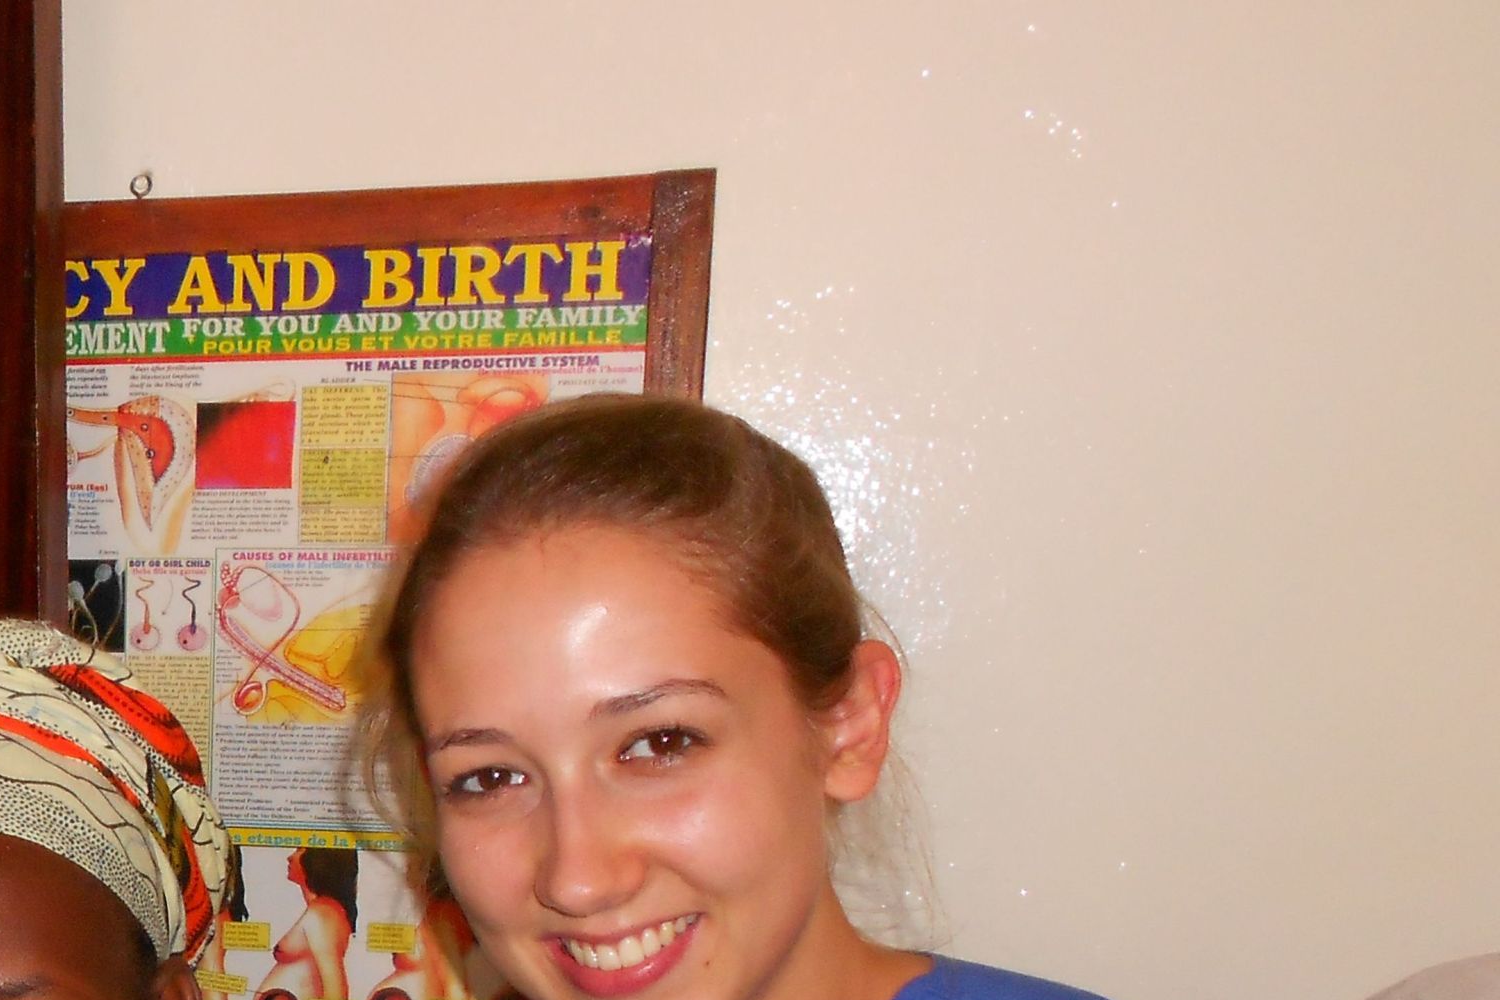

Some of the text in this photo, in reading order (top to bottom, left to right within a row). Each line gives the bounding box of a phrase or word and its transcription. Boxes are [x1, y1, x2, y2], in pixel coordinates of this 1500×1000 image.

[167, 252, 337, 315] AND
[362, 240, 626, 309] BIRTH
[181, 316, 245, 339] FOR
[255, 314, 322, 338] YOU
[331, 311, 403, 335] AND
[413, 308, 506, 332] YOUR
[516, 305, 646, 328] FAMILY
[203, 329, 622, 354] POUR VOUS ET VOTRE FAMILLE
[346, 354, 600, 373] THE MALE REPRODUCTIVE SYSTEM
[129, 560, 211, 568] BOY OR GIRL CHILD
[233, 552, 398, 561] CAUSES OF MALE INFERTILIT
[247, 833, 302, 846] etapes
[308, 834, 326, 847] de
[333, 835, 349, 848] la
